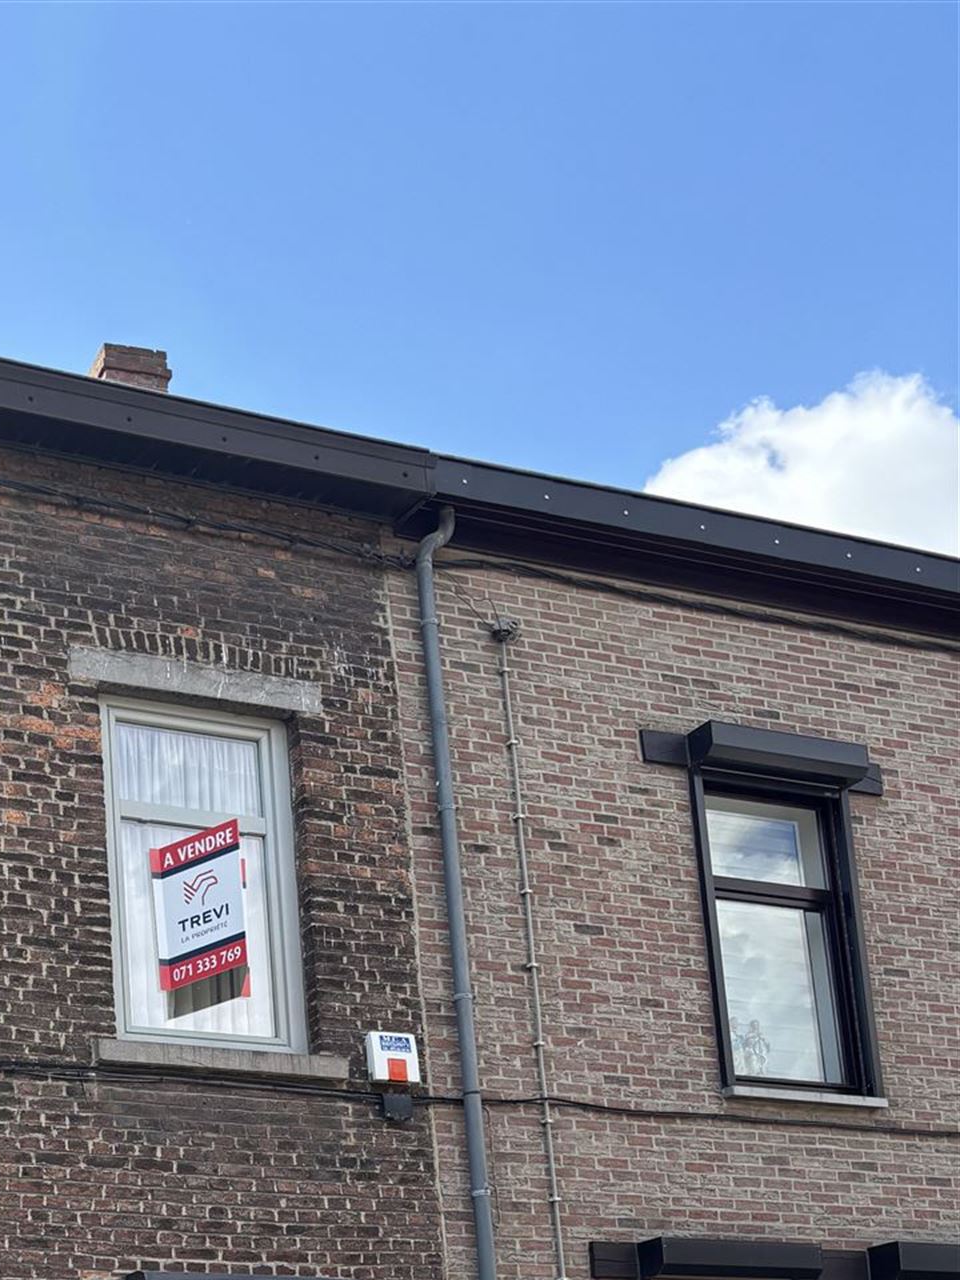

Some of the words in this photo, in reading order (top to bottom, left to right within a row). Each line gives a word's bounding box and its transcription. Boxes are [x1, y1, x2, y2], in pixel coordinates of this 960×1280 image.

[163, 852, 174, 868] A
[177, 827, 234, 862] VENDRE
[178, 903, 229, 932] TREVI
[181, 936, 190, 944] LA
[173, 963, 193, 982] 071
[196, 955, 217, 974] 333
[220, 946, 242, 965] 769
